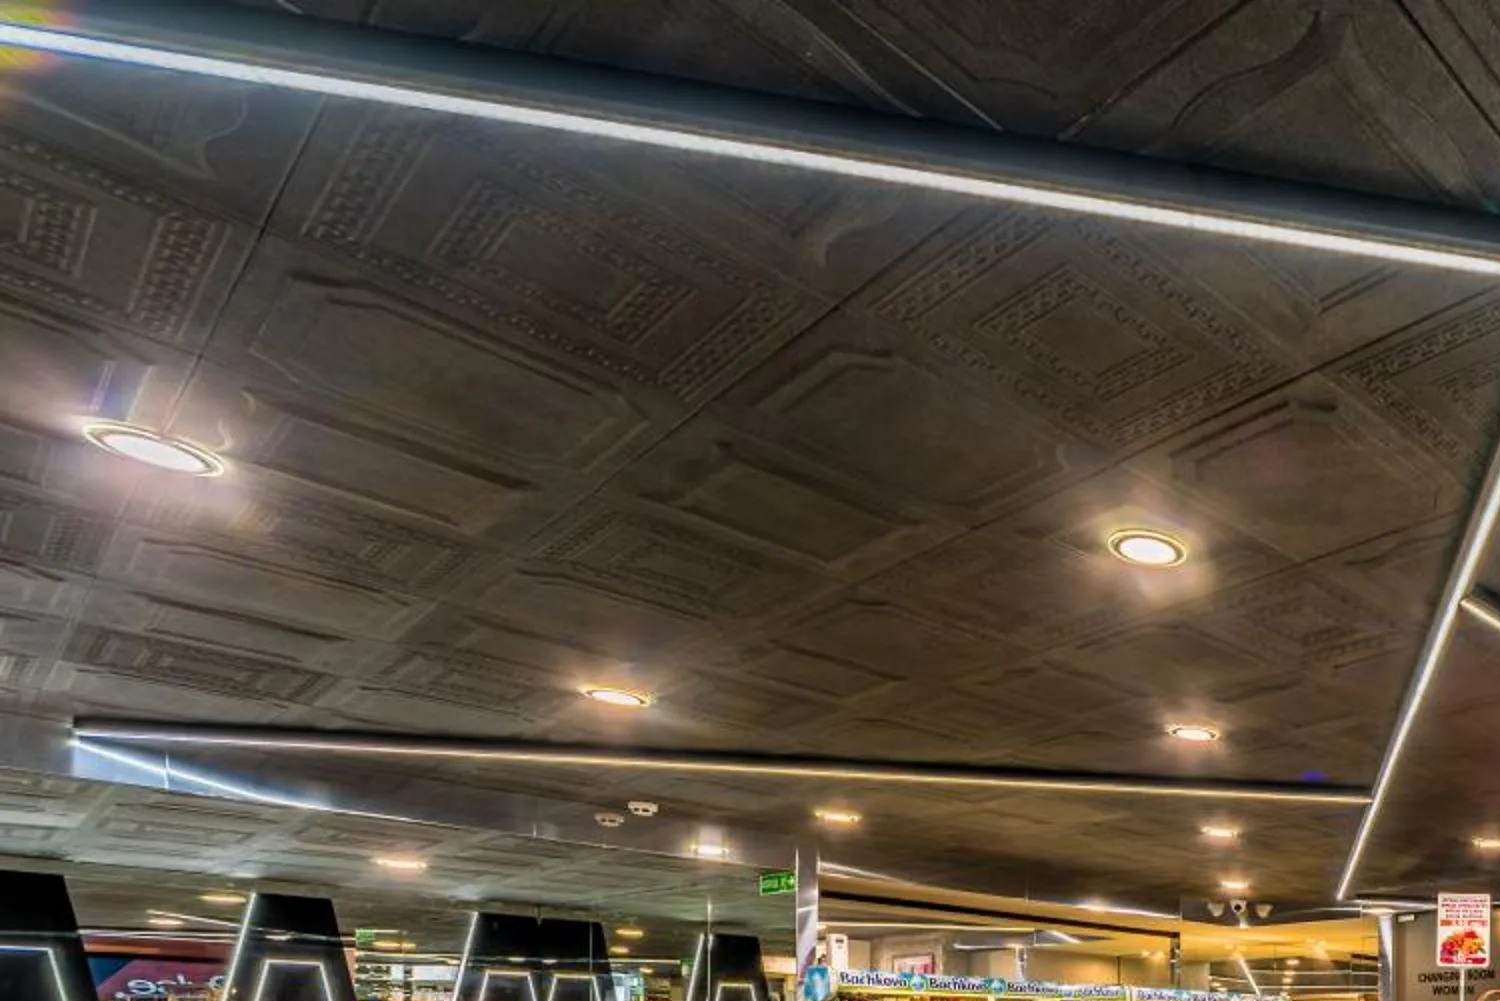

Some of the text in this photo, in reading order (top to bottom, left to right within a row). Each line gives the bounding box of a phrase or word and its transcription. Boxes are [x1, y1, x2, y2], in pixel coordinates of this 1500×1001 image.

[839, 970, 908, 987] Bachkovo
[928, 976, 990, 992] Bachkovo
[1432, 985, 1475, 996] WOMN
